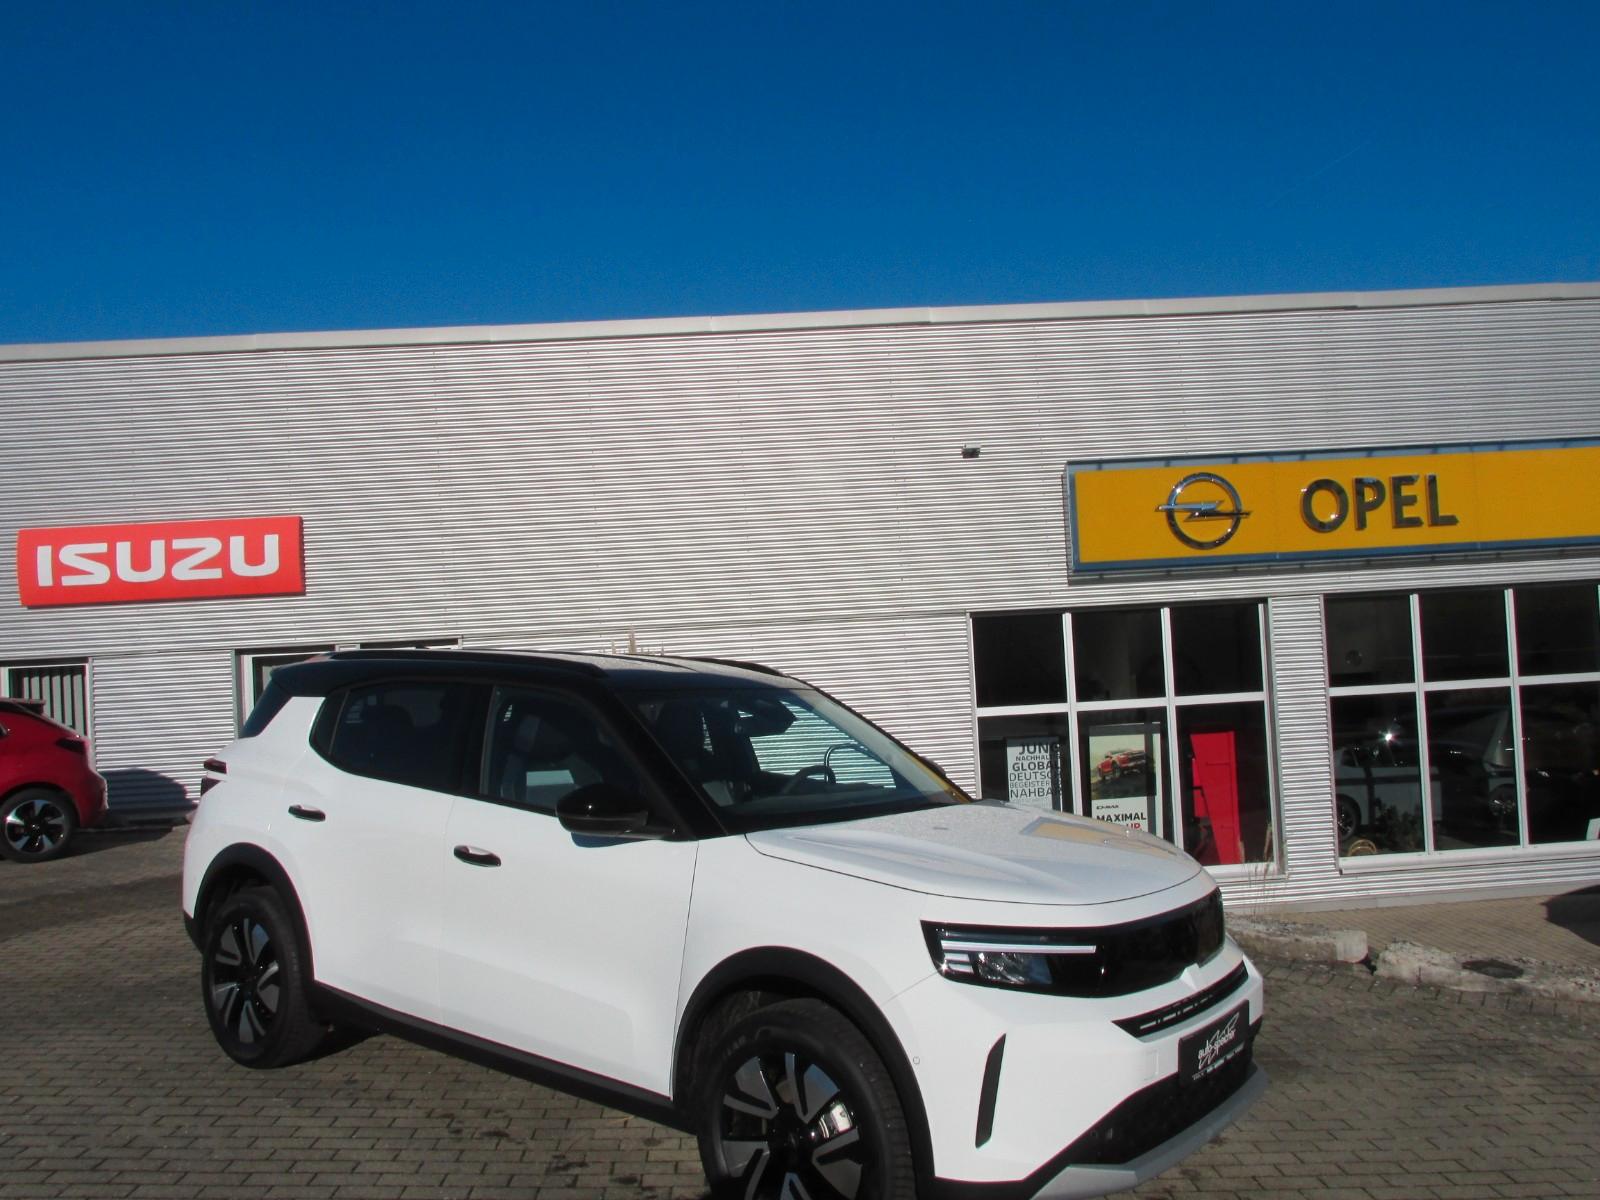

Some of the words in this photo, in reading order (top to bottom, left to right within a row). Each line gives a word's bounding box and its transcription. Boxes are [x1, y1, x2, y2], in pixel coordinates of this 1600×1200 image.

[1301, 473, 1459, 533] OPEL
[36, 534, 280, 587] ISUZU
[1096, 812, 1147, 823] MAXIMAL
